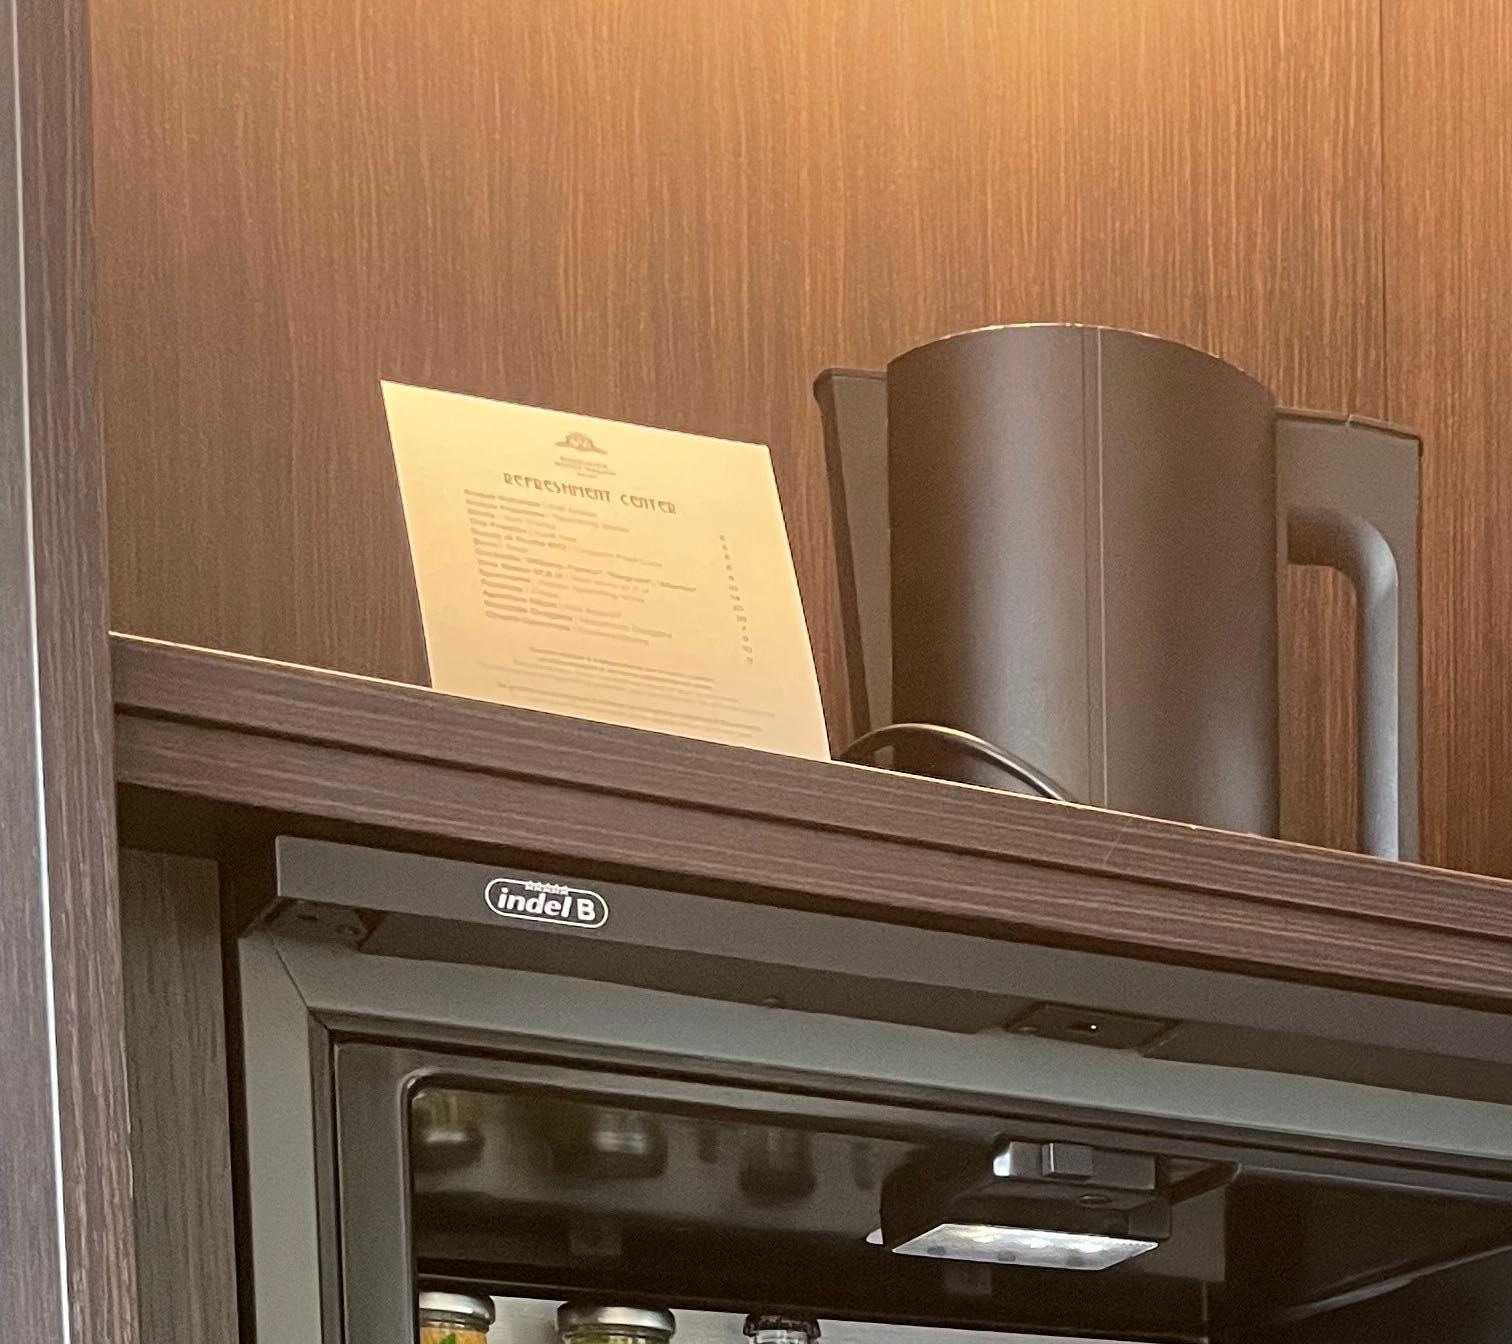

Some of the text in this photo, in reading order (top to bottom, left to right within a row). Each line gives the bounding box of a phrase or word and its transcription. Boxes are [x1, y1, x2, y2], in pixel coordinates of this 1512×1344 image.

[503, 472, 677, 515] REFRESHMENT CENTER
[498, 887, 596, 921] indel B
